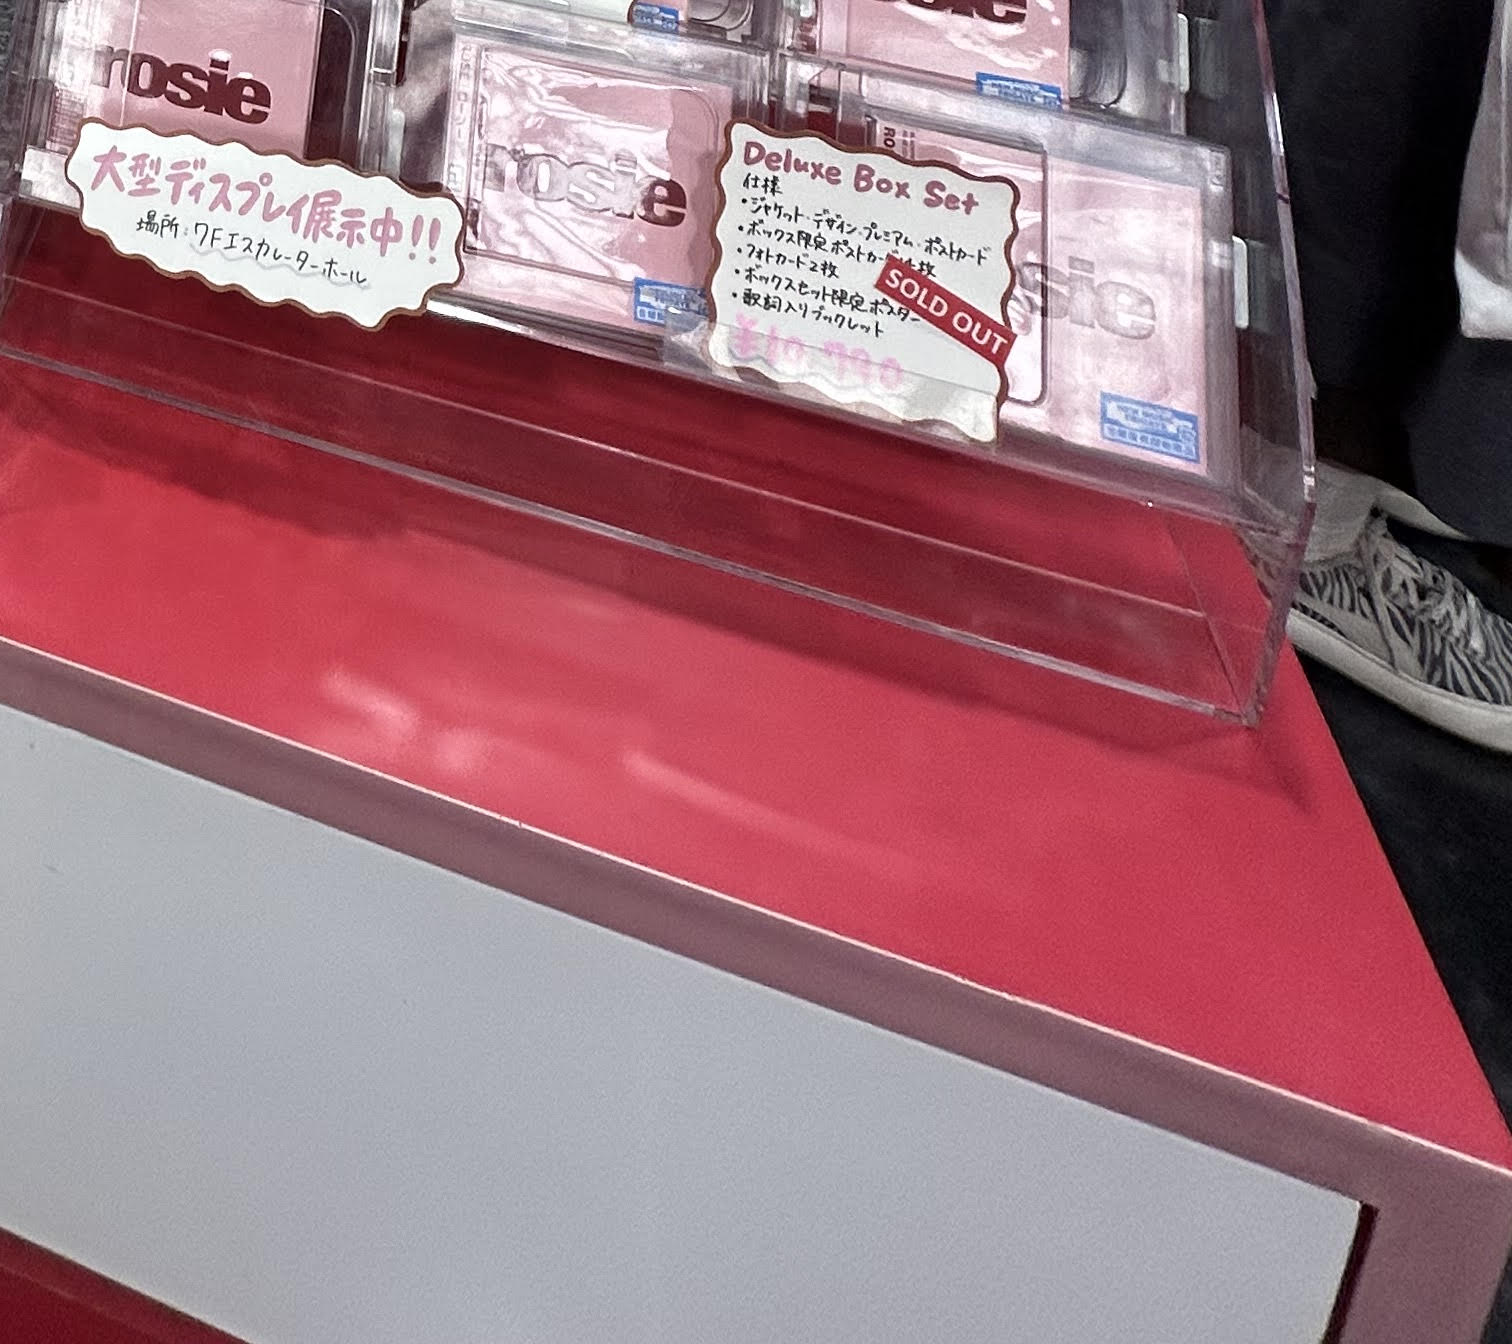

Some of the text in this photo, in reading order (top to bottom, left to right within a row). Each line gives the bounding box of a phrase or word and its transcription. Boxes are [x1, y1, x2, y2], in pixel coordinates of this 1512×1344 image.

[92, 44, 272, 125] rosie
[91, 145, 442, 265] 大型ディスプレイ展示中!!
[742, 173, 783, 195] 仕様
[743, 141, 980, 215] Deluxe Box Set
[884, 268, 1009, 356] SOLD OUT
